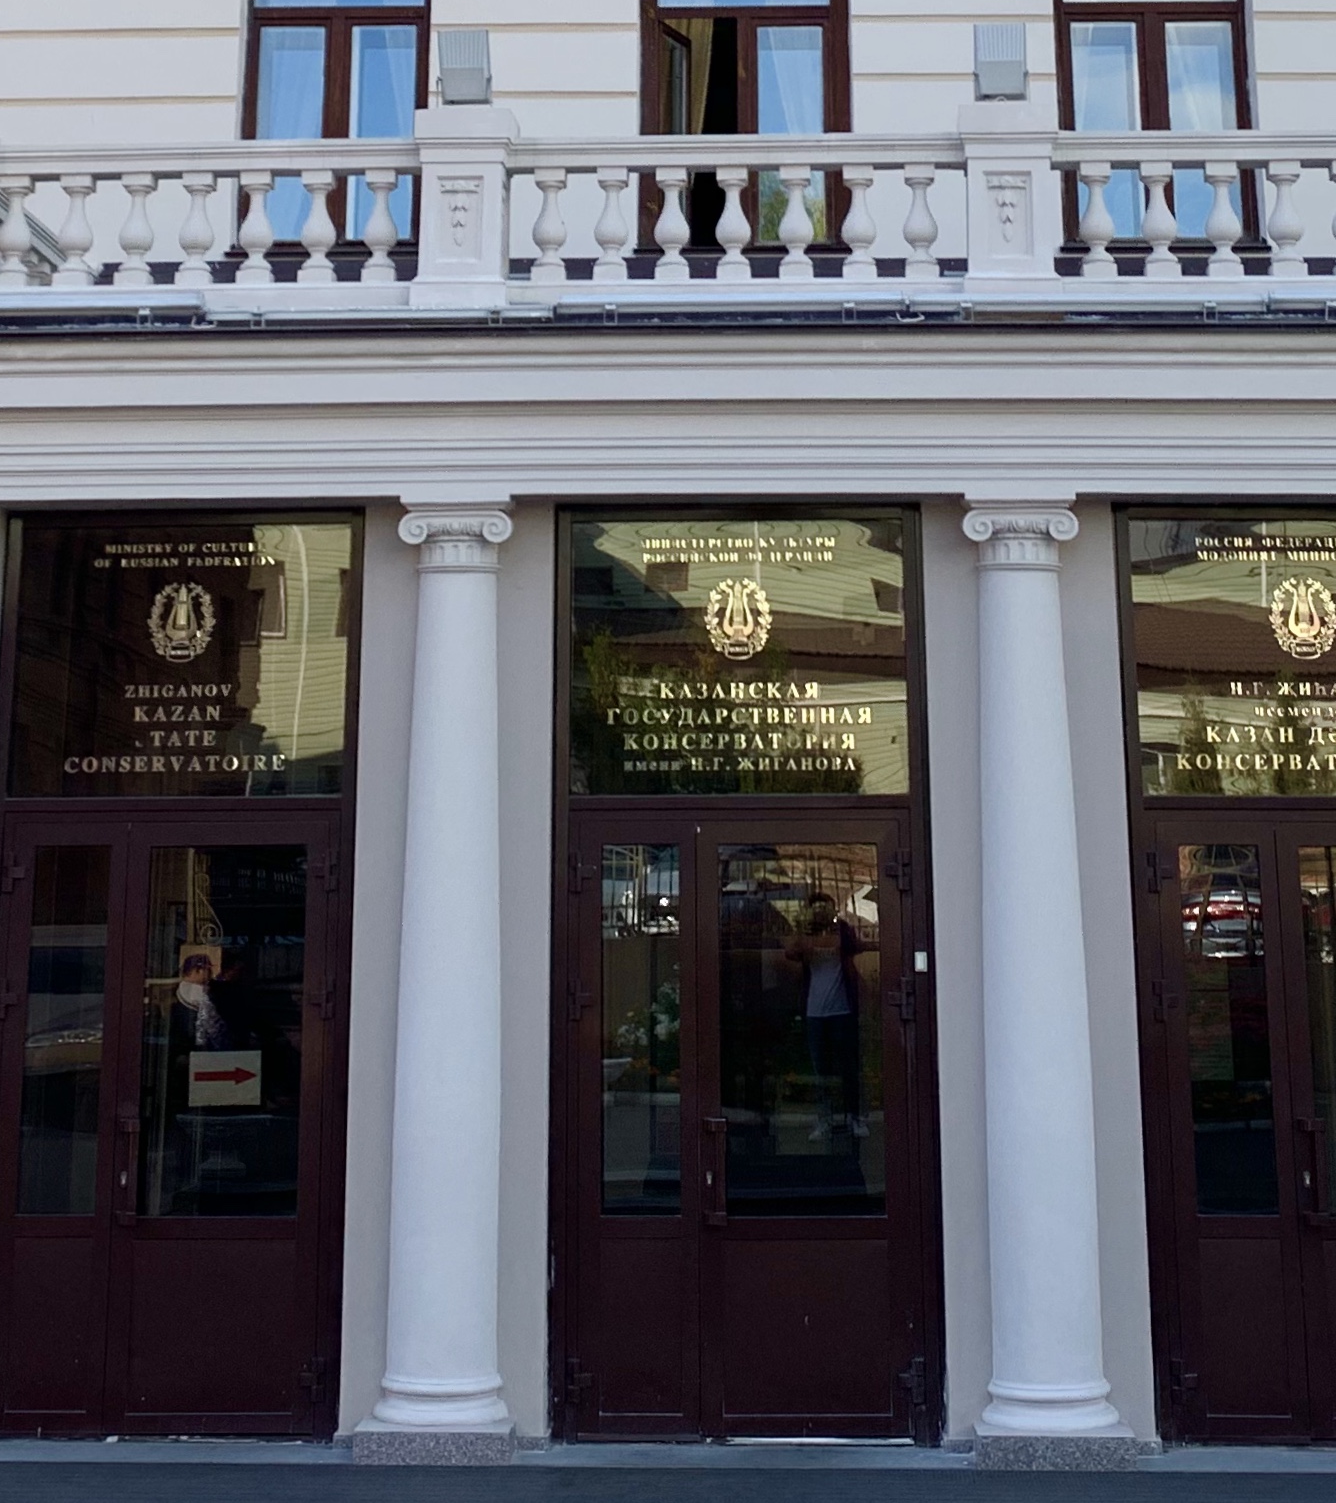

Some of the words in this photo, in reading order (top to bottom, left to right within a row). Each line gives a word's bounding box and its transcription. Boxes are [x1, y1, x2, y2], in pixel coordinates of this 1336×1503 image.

[105, 542, 173, 554] MINISTRY
[178, 542, 197, 554] OF
[1195, 537, 1253, 548] РОССИЯ
[94, 557, 112, 568] OF
[121, 557, 179, 568] RUSSIAN
[124, 683, 232, 698] ZHIGANOV
[660, 681, 819, 699] КАЗАНСКАЯ
[133, 705, 221, 722] KAZAN
[607, 706, 872, 727] ГОСУДАРСТВЕННАЯ
[135, 730, 216, 747] TATE
[623, 732, 856, 750] КОНСЕРВАТОРИЯ
[1206, 726, 1294, 743] КАЗАН
[64, 754, 286, 774] CONSERVATOIRE
[737, 757, 857, 771] ЖИГАНОВА
